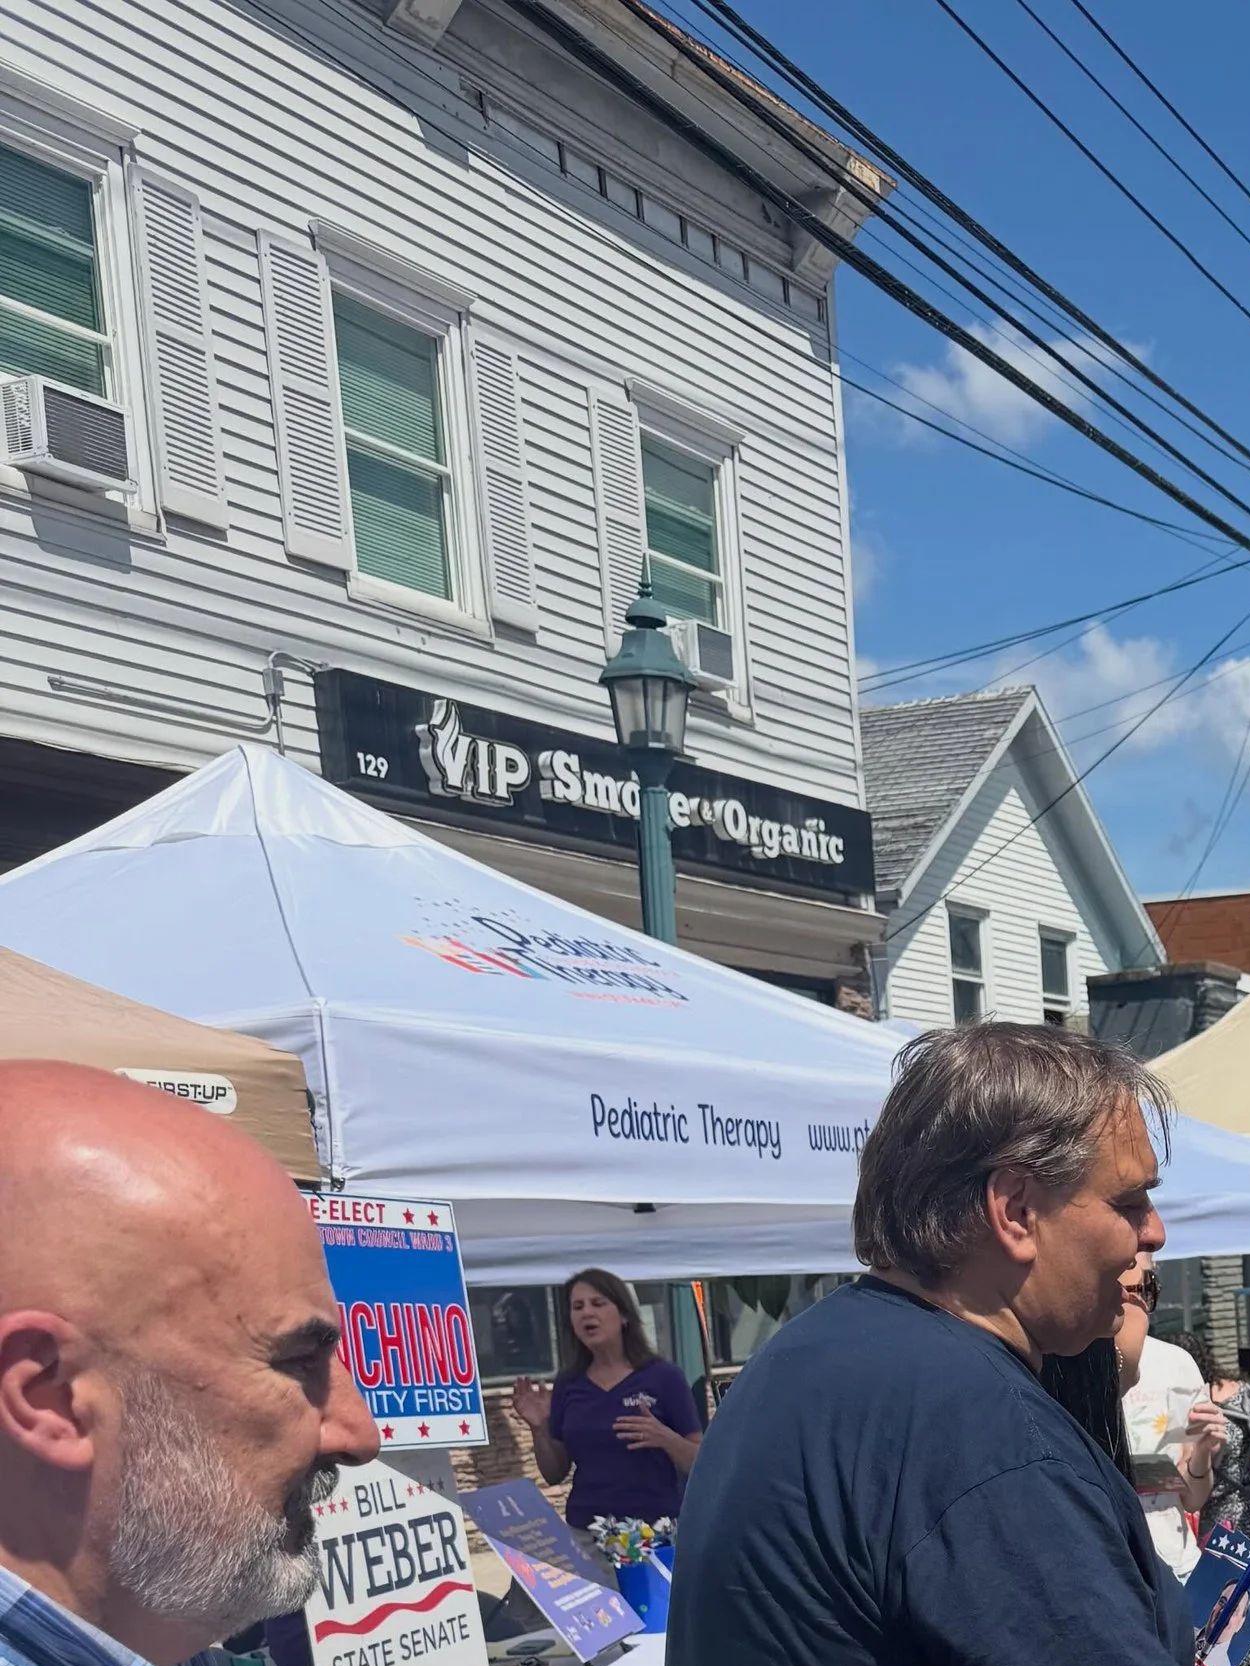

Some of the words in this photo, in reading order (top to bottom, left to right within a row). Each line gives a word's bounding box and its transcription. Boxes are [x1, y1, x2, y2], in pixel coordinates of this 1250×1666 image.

[357, 752, 388, 778] 129
[424, 699, 531, 803] VIP
[545, 749, 691, 828] Smoe
[701, 801, 714, 820] &
[722, 799, 845, 864] Organic
[590, 1093, 690, 1143] Pediatric
[698, 1103, 782, 1159] Therapy
[309, 1198, 386, 1223] E-ELECT
[320, 1226, 355, 1246] TOWN
[357, 1229, 410, 1249] COUNCIL
[445, 1235, 453, 1252] 3
[365, 1389, 408, 1415] ITY
[414, 1388, 473, 1413] FIRST
[354, 1478, 406, 1518] BILL
[318, 1511, 466, 1610] WEBER
[399, 1613, 471, 1661] SENATE
